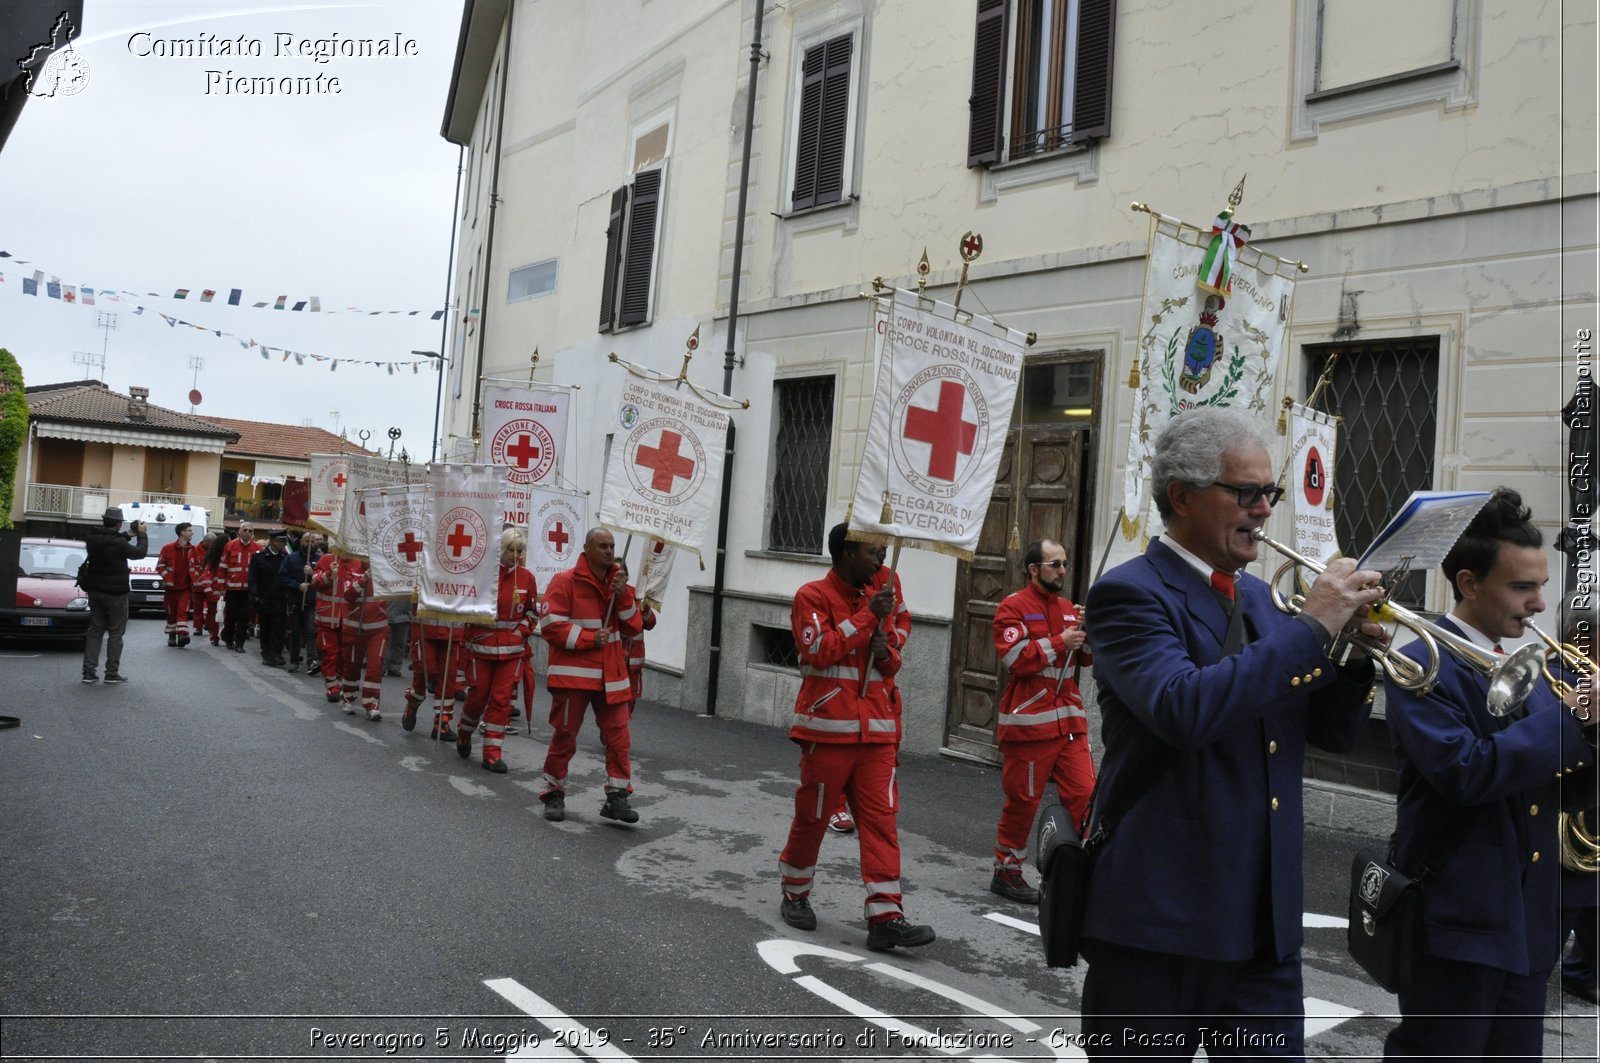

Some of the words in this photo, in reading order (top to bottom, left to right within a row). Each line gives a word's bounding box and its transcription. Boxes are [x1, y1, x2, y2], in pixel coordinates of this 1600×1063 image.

[1173, 264, 1201, 280] COMU
[897, 315, 923, 333] CORPO
[926, 327, 965, 348] VOLONTARI
[967, 338, 978, 354] DEL
[980, 345, 1015, 366] SOCCORSO
[887, 330, 930, 353] CROCE
[931, 344, 970, 367] ROSSA
[971, 356, 1017, 383] ITALIANA
[494, 399, 513, 410] CROCE
[514, 401, 533, 412] ROSSA
[533, 403, 558, 414] ITALIANA
[629, 383, 649, 397] CORPO
[650, 391, 683, 407] VOLONTARI
[684, 401, 696, 412] DEL
[696, 406, 727, 421] SOCCORSO
[899, 366, 962, 405] CONVENZIONE
[963, 374, 970, 385] DI
[968, 381, 989, 428] GINEVRA
[623, 392, 655, 410] CROCE
[657, 405, 688, 421] ROSSA
[690, 412, 728, 432] ITALIANA
[493, 421, 530, 457] CONVENZIONE
[531, 423, 539, 432] DI
[539, 429, 552, 461] GINEVRA
[630, 419, 678, 443] CONVENZIONE
[507, 469, 531, 483] AGOSTO
[516, 501, 524, 509] di
[620, 499, 660, 516] COMITATO
[666, 512, 694, 528] LOCALE
[625, 511, 682, 536] MORETTA
[892, 510, 965, 537] EVERAGNO
[434, 582, 477, 597] MANTA
